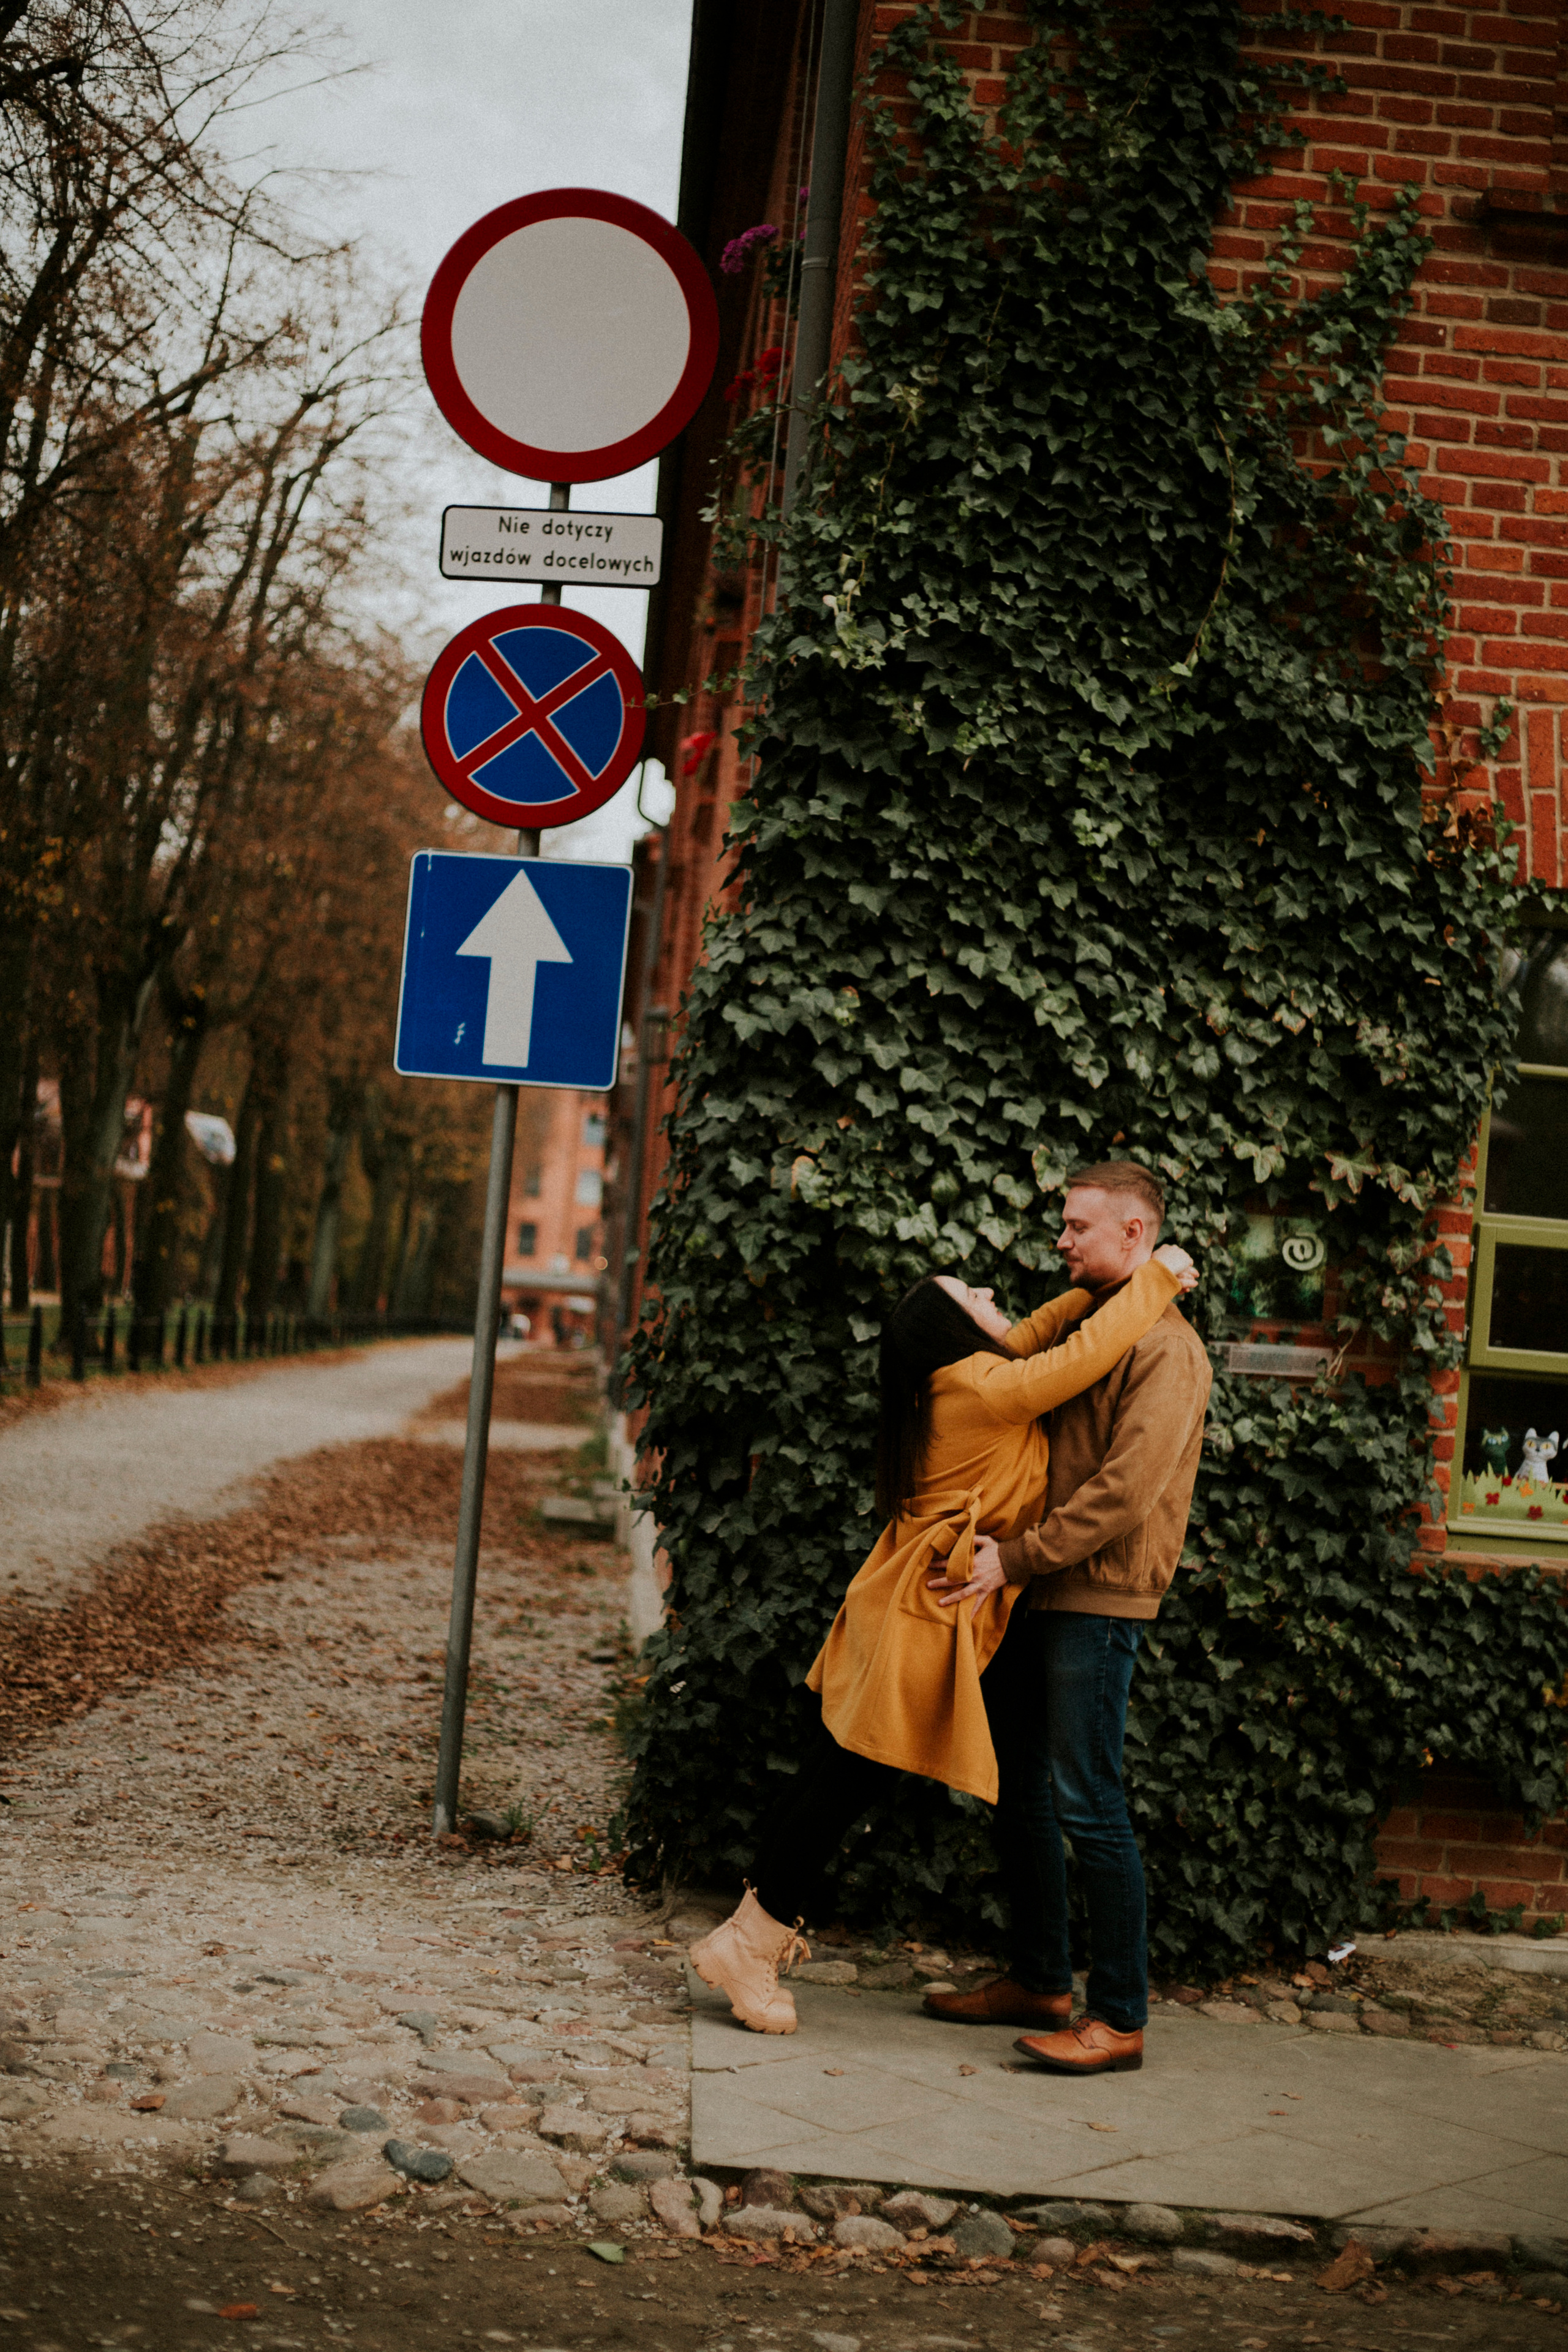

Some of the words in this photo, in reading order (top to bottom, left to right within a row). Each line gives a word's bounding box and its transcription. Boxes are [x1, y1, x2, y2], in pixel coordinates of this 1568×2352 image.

[499, 516, 530, 535] Nie
[541, 518, 614, 543] dotyczy
[450, 545, 532, 567] wjazdów
[543, 549, 654, 576] docelowych
